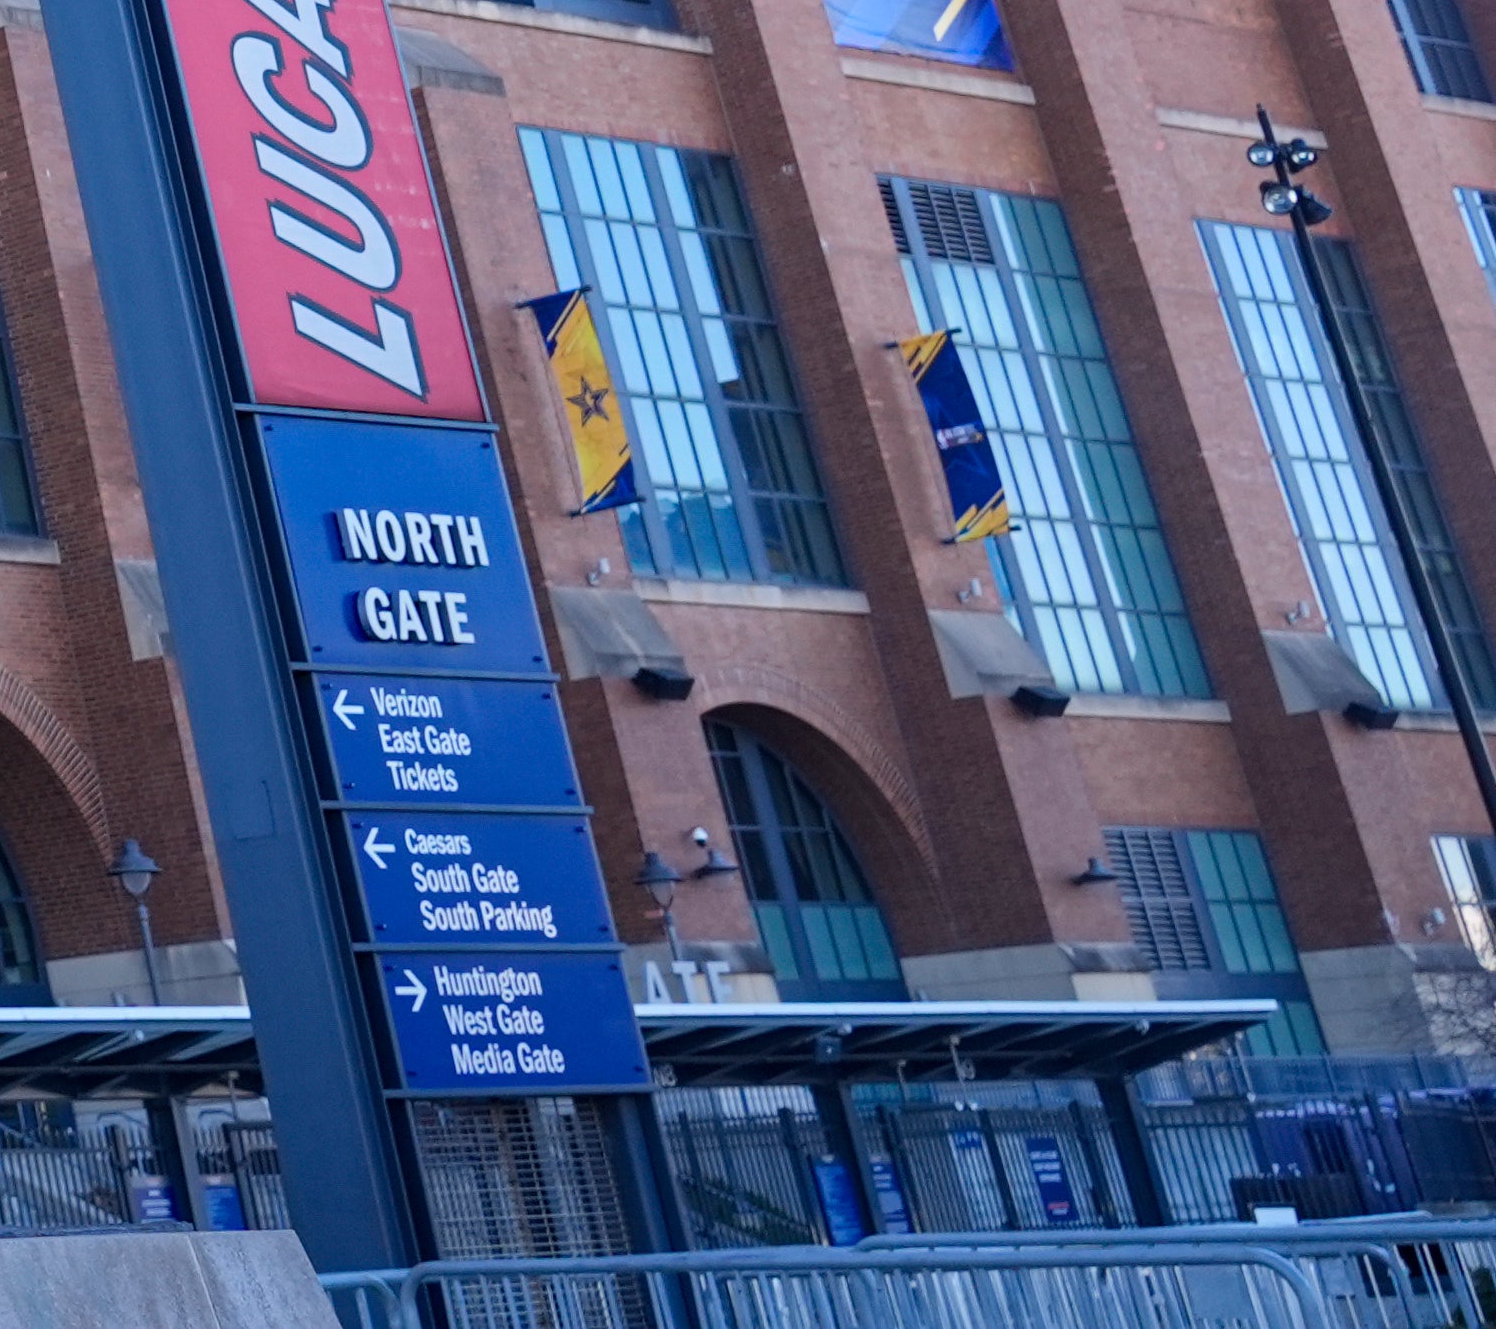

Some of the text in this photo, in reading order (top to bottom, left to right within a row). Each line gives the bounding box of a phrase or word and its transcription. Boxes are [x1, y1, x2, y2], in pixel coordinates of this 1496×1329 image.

[338, 506, 489, 567] NORTH
[359, 587, 475, 644] GATE
[371, 686, 442, 719] Verizon
[378, 722, 472, 757] East Gate
[387, 759, 458, 794] Tickets
[405, 827, 472, 857] Caesars
[410, 861, 520, 896] South Gate
[420, 899, 557, 939] South Parking
[433, 964, 542, 999] Huntington
[645, 961, 732, 1003] ATE
[442, 1002, 545, 1037] West Gate
[451, 1040, 565, 1075] Media Gate
